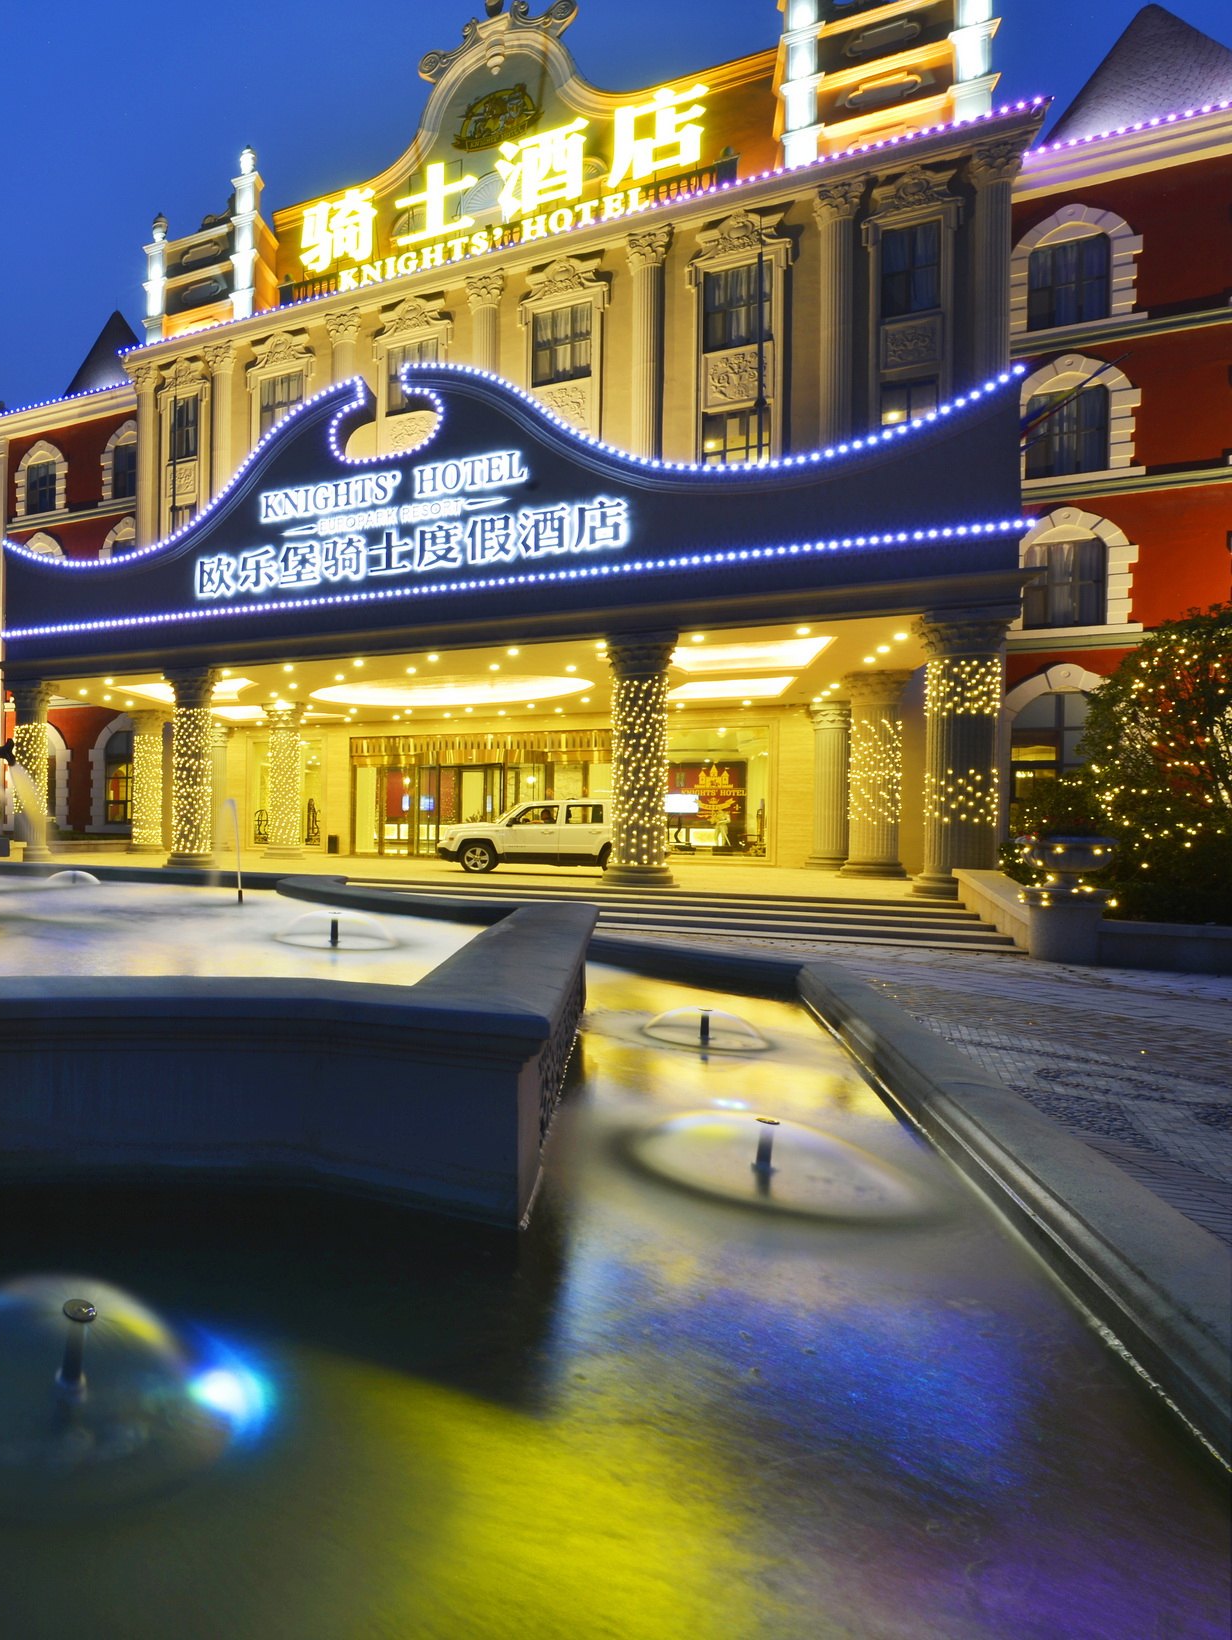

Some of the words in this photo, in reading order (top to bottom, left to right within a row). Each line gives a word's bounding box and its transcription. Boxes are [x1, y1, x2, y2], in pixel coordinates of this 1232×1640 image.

[300, 84, 711, 273] 骑士酒店
[339, 227, 502, 292] KNIGHTS'
[521, 187, 650, 243] HOTEL
[262, 472, 402, 519] KNIGHTS'
[416, 452, 529, 496] HOTEL
[401, 500, 463, 521] RESORT
[197, 499, 629, 598] 欧乐堡骑士度假酒店
[720, 788, 747, 796] HOTEL
